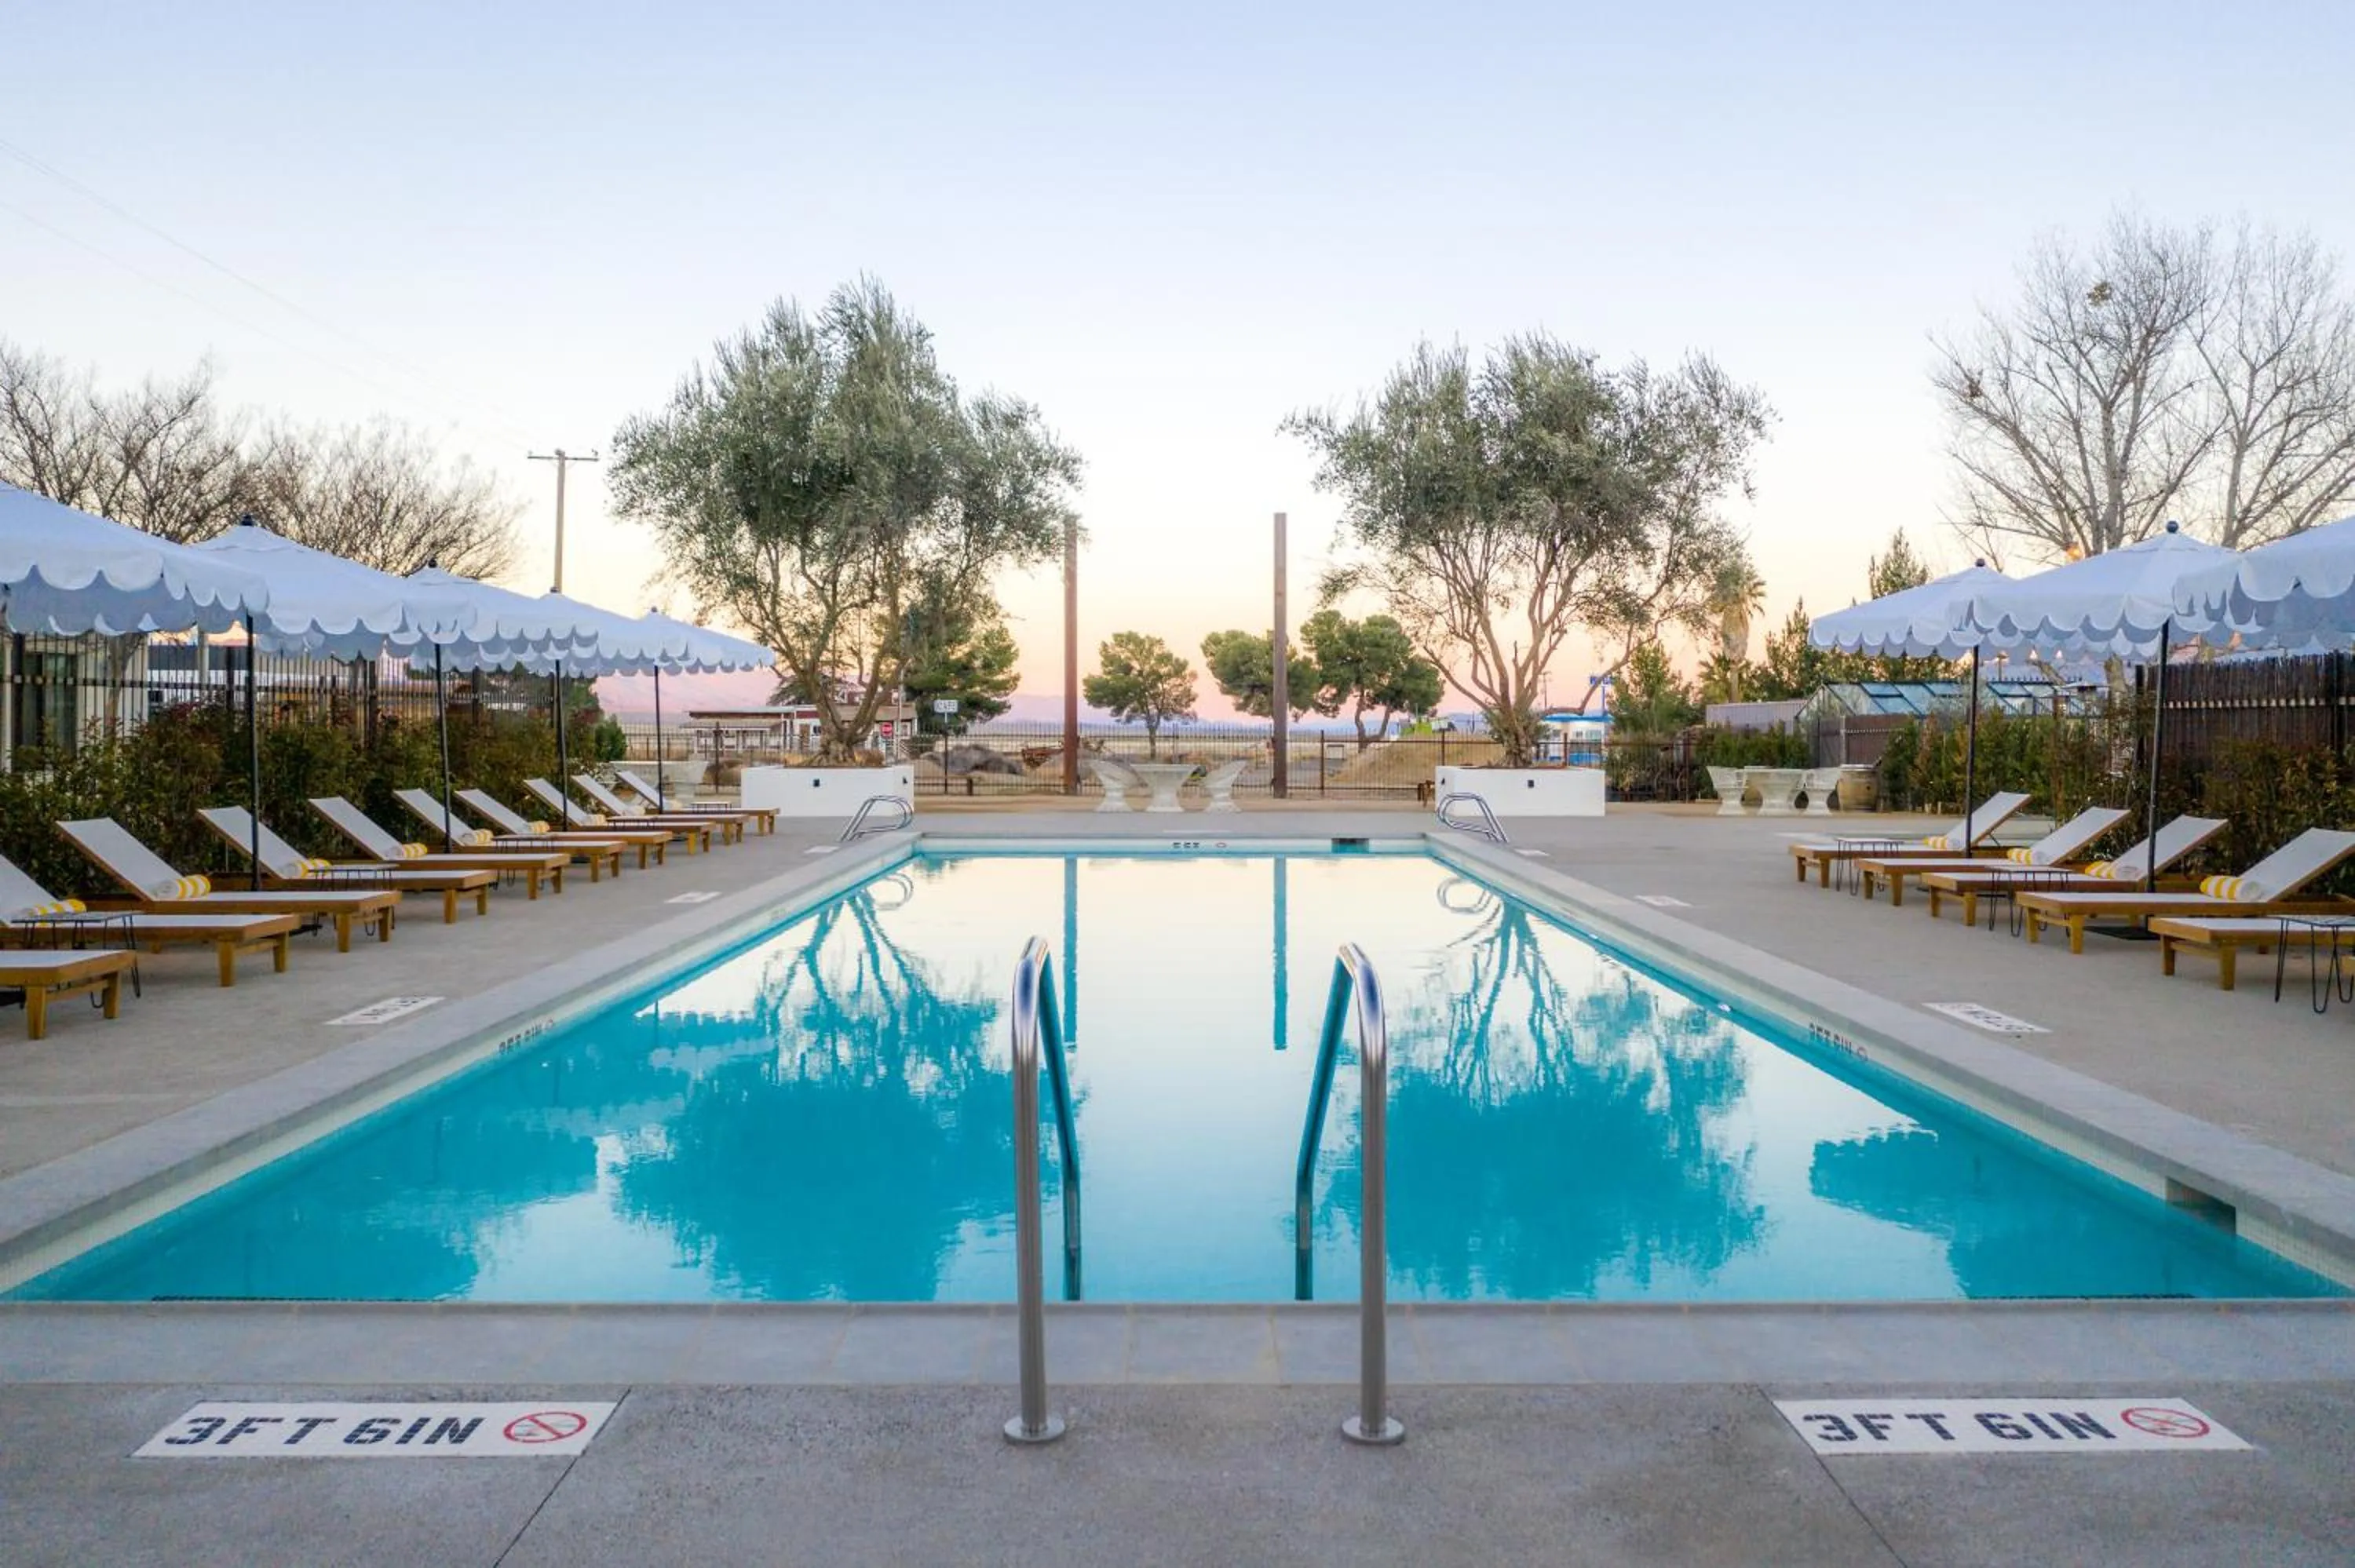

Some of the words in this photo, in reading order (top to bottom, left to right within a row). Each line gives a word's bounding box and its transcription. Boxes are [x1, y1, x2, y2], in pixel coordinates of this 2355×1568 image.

[164, 1417, 339, 1445] 3FT
[342, 1417, 487, 1445] 6IN
[1802, 1413, 1956, 1442] 3FT
[1973, 1412, 2117, 1441] 6IN
